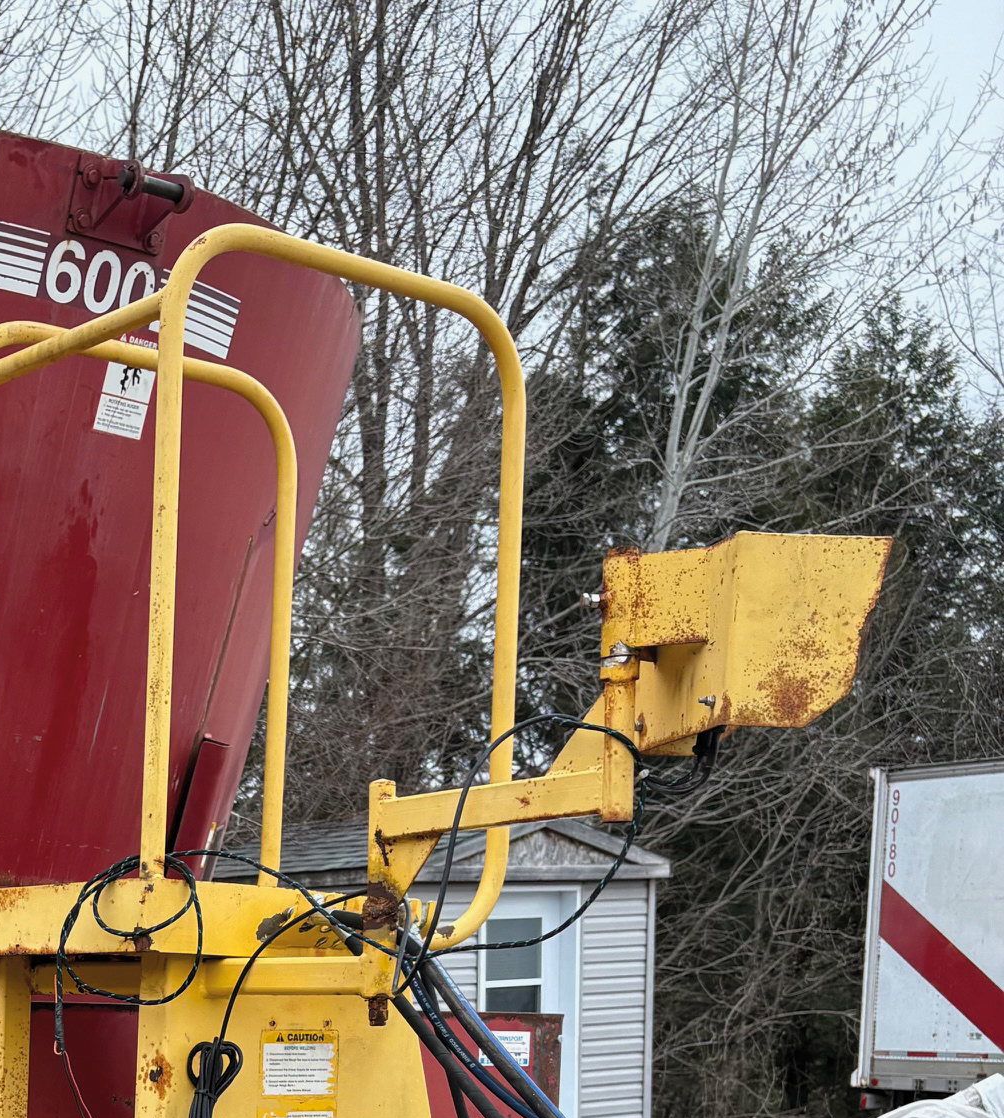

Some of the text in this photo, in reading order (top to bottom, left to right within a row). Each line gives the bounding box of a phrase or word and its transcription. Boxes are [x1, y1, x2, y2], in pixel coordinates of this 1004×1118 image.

[45, 239, 156, 314] 600
[129, 336, 158, 349] DANGER
[888, 789, 900, 877] 90180
[429, 1012, 437, 1020] 2T
[287, 1033, 324, 1042] CAUTION
[449, 1038, 470, 1063] intertraco
